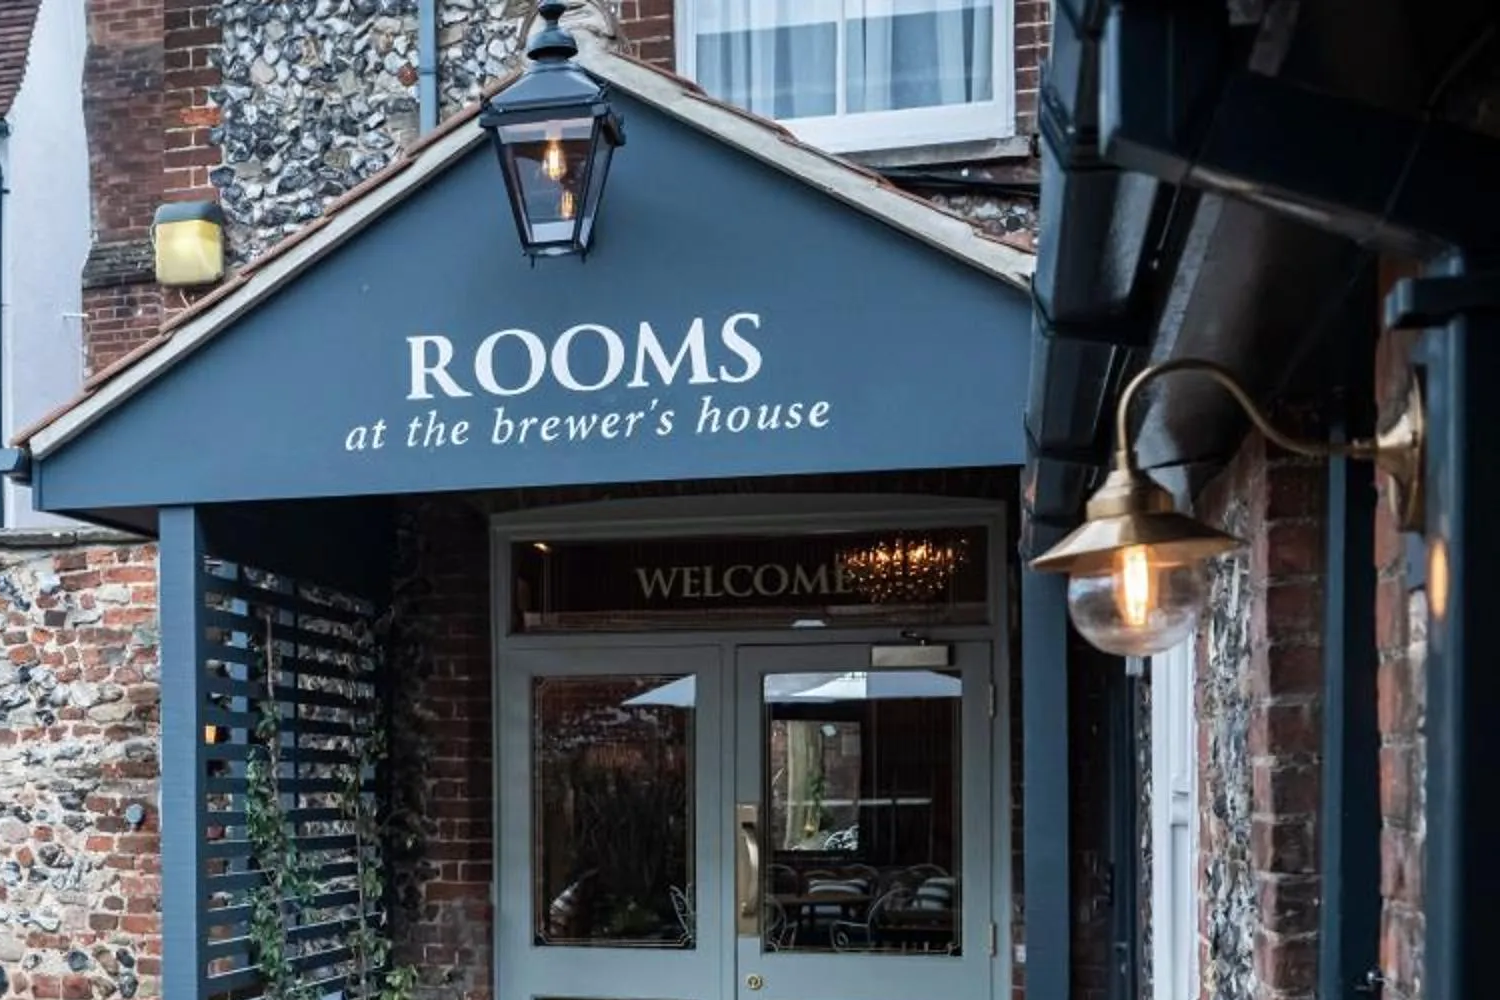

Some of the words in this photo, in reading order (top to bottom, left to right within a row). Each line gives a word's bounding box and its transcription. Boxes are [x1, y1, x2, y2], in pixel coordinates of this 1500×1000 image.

[405, 312, 764, 400] ROOMS
[345, 418, 386, 451] at
[406, 410, 469, 447] the
[492, 398, 675, 444] brewer's
[697, 396, 831, 434] house
[637, 563, 854, 598] WELCOME
